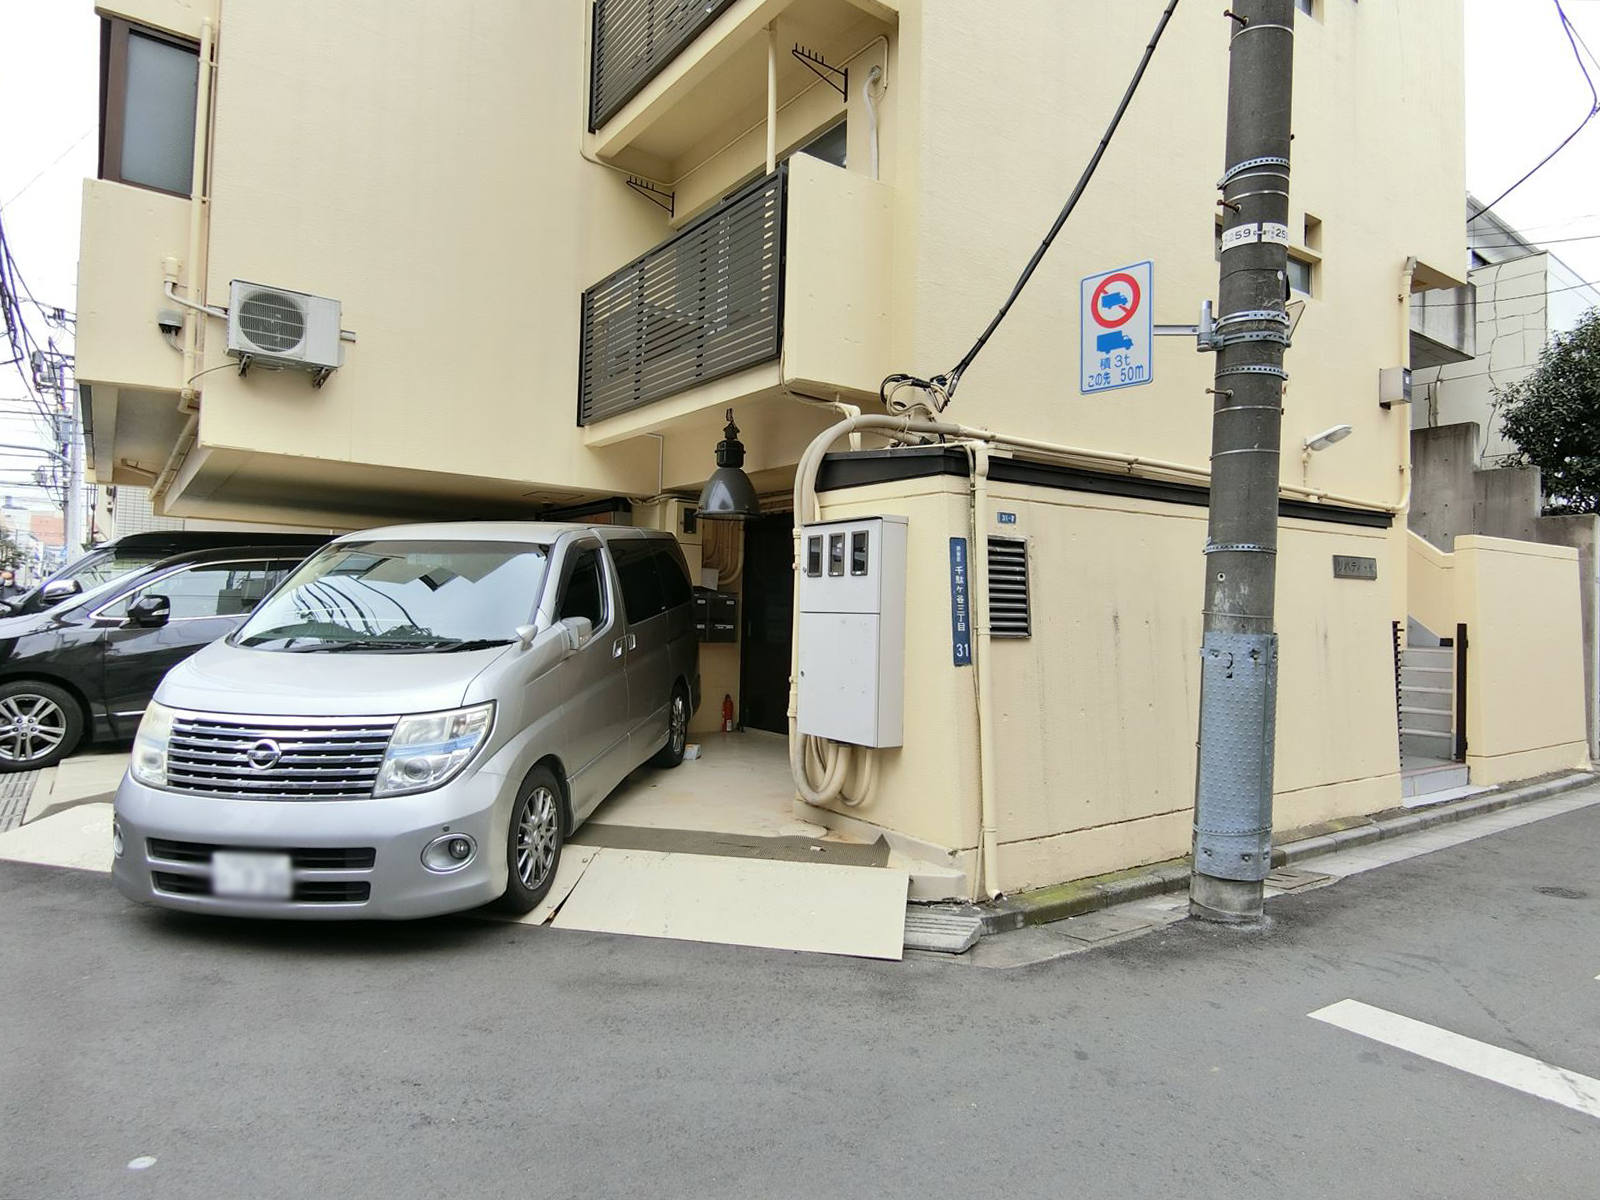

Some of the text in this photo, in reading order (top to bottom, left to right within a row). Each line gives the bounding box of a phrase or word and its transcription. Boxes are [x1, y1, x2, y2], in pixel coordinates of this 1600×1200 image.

[1100, 354, 1130, 370] 積 3t
[1088, 364, 1144, 387] この先 50m
[956, 643, 969, 657] 31
